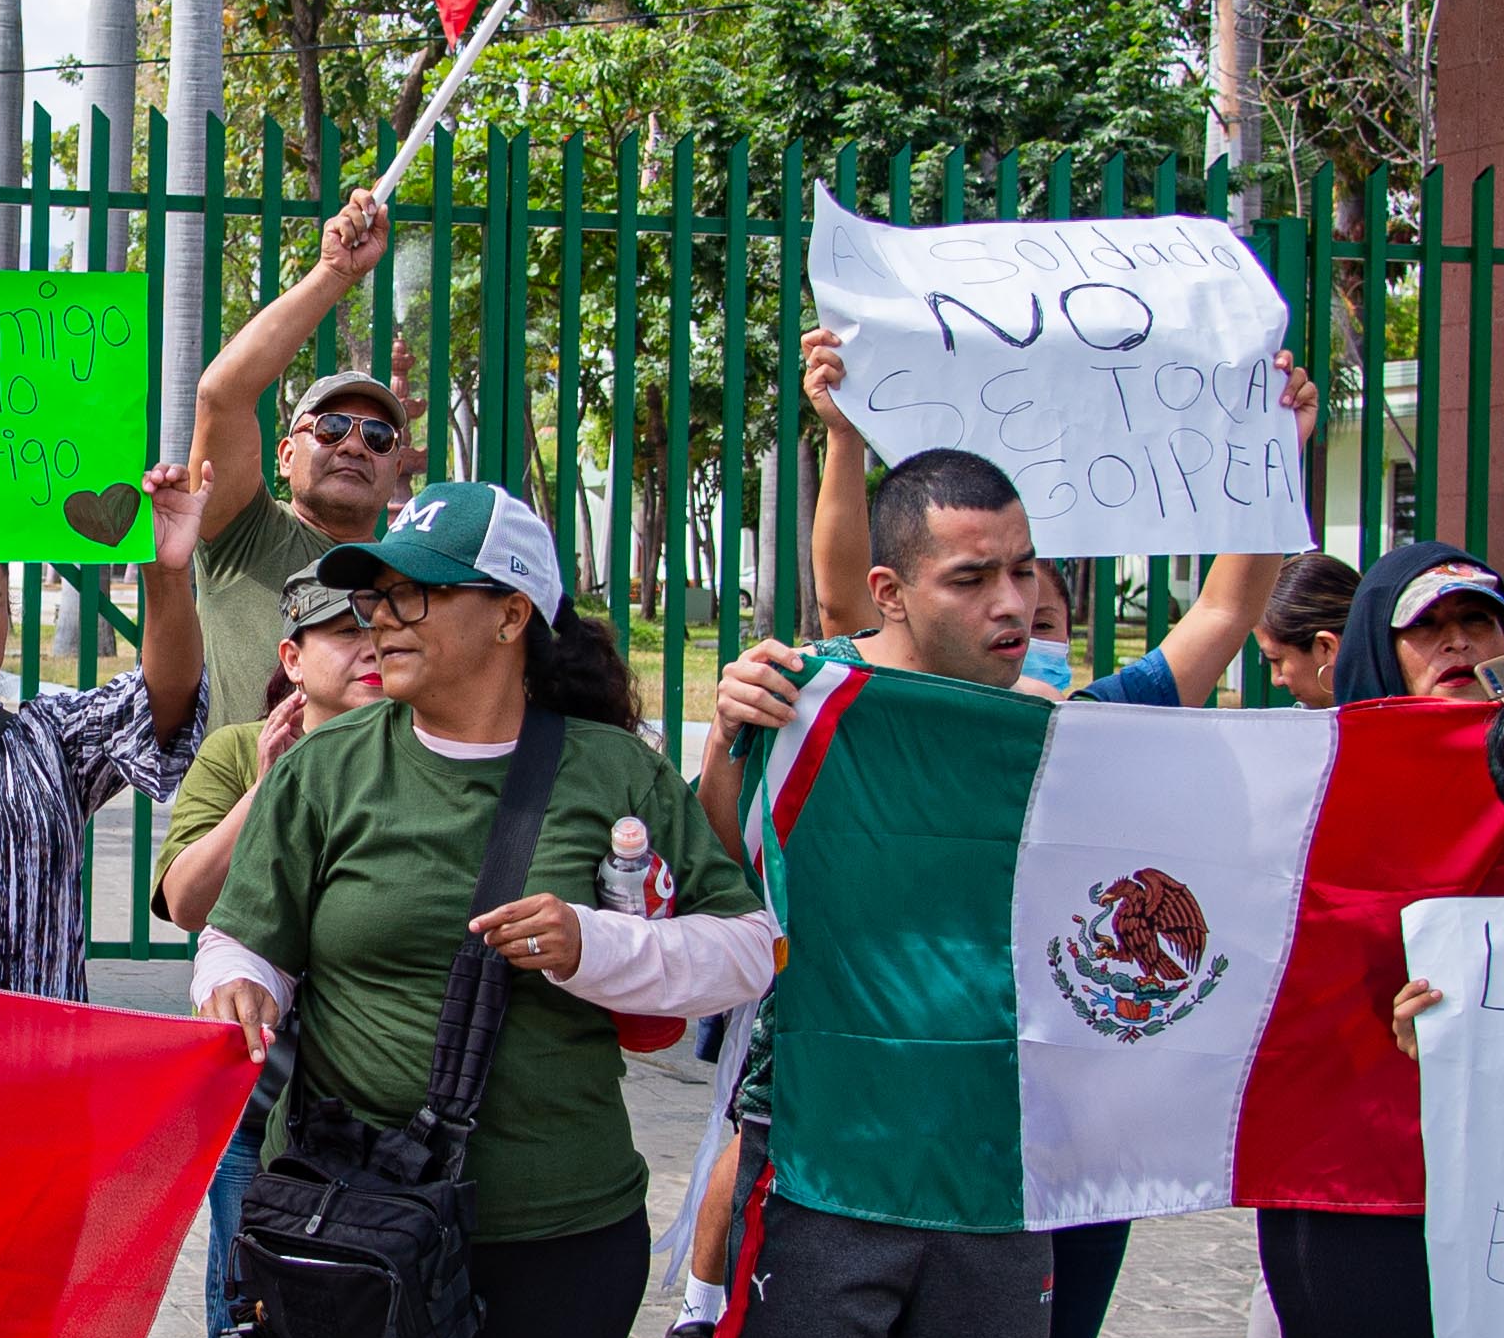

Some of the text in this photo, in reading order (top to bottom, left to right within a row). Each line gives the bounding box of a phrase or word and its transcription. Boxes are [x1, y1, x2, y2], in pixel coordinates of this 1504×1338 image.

[929, 224, 1241, 285] Soldado
[924, 281, 1154, 356] NO
[868, 357, 1268, 452] SE TOCA
